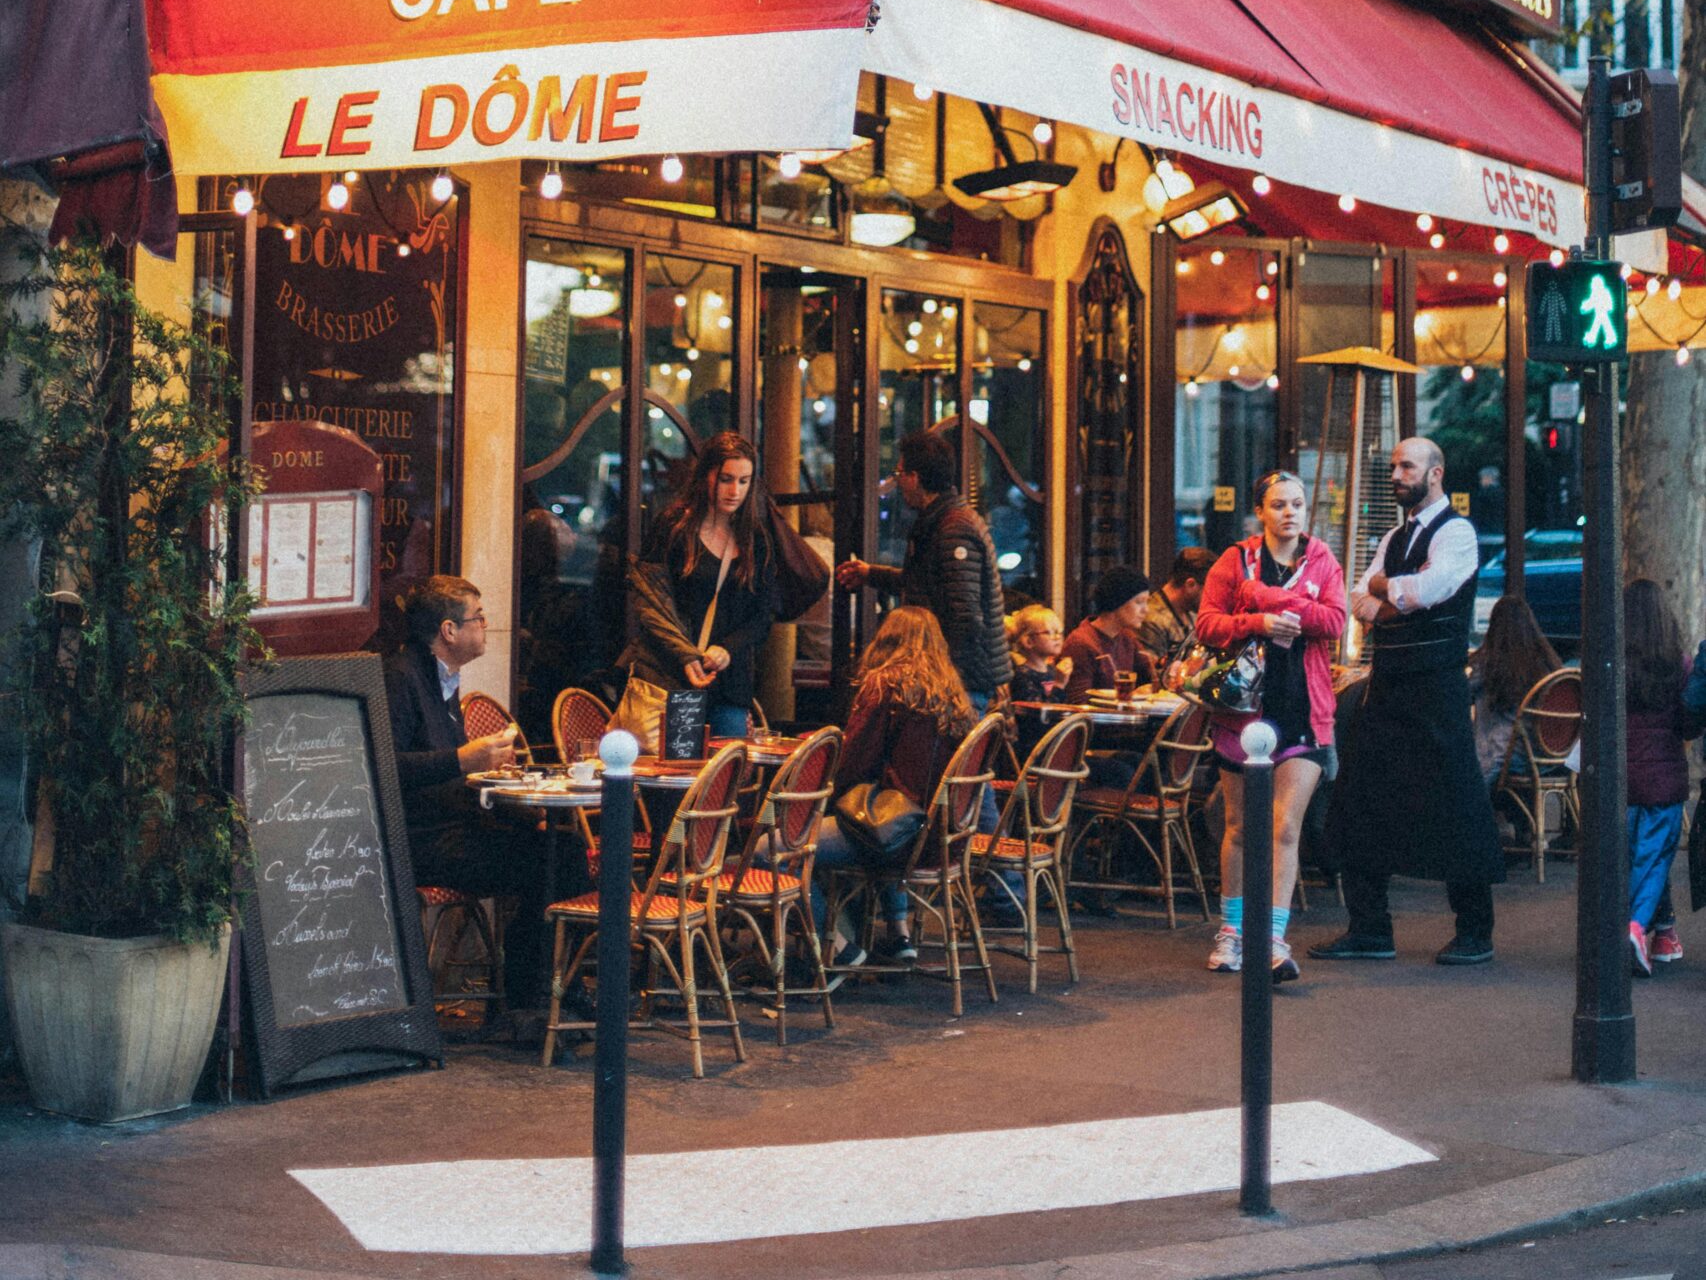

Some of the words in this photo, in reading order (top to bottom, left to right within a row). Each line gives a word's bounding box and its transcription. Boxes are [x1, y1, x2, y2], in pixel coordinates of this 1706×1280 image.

[280, 89, 380, 158] LE
[412, 63, 648, 151] DÔME
[1110, 63, 1263, 159] SNACKING
[289, 217, 387, 273] DÔME
[275, 279, 400, 344] BRASSERIE
[272, 451, 324, 468] DOME
